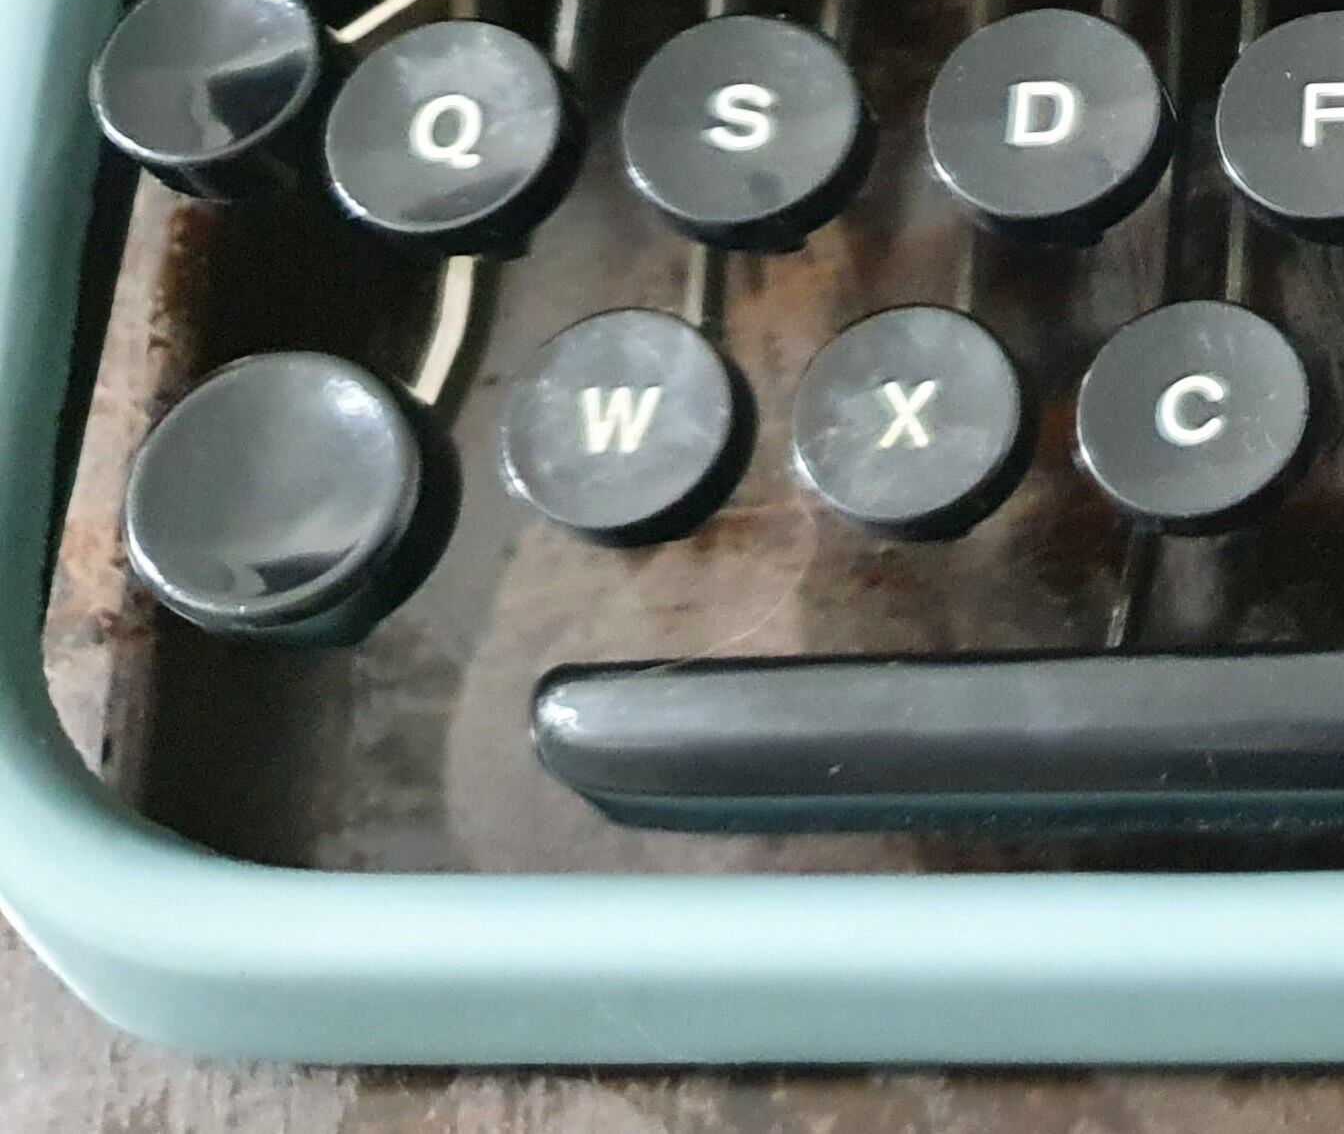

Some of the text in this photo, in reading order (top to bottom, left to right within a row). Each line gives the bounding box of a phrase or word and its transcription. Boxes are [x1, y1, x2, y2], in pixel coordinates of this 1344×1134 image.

[409, 94, 482, 169] Q
[706, 83, 775, 151] S
[1008, 81, 1078, 147] D
[581, 386, 662, 454] W
[877, 380, 934, 449] X
[1155, 374, 1228, 446] C
